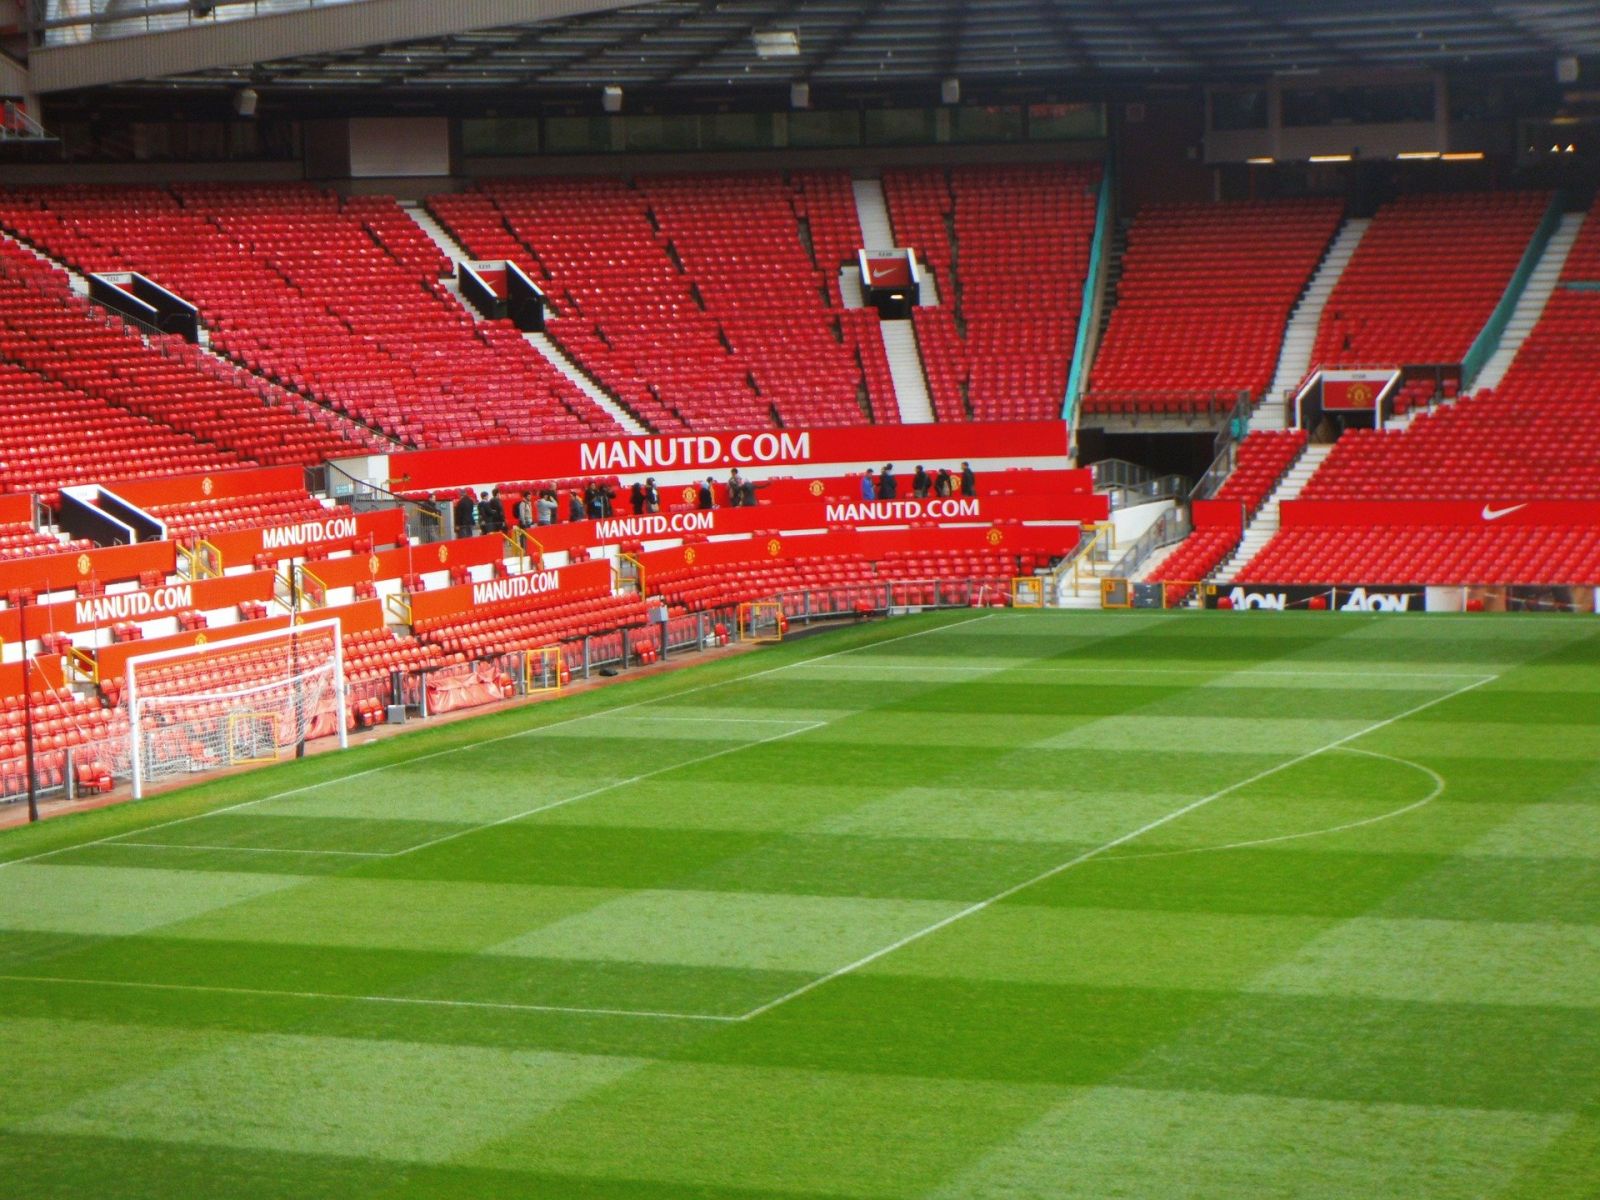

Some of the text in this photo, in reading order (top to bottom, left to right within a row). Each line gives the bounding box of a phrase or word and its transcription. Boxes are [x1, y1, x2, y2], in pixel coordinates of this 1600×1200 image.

[580, 432, 810, 470] MANUTD.COM
[596, 512, 713, 539] MANUTD.COM
[825, 499, 980, 521] MANUTD.COM
[262, 517, 357, 549] MANUTD.COM
[473, 570, 559, 605] MANUTD.COM
[1340, 587, 1410, 612] AON
[76, 584, 192, 624] MANUTD.COM
